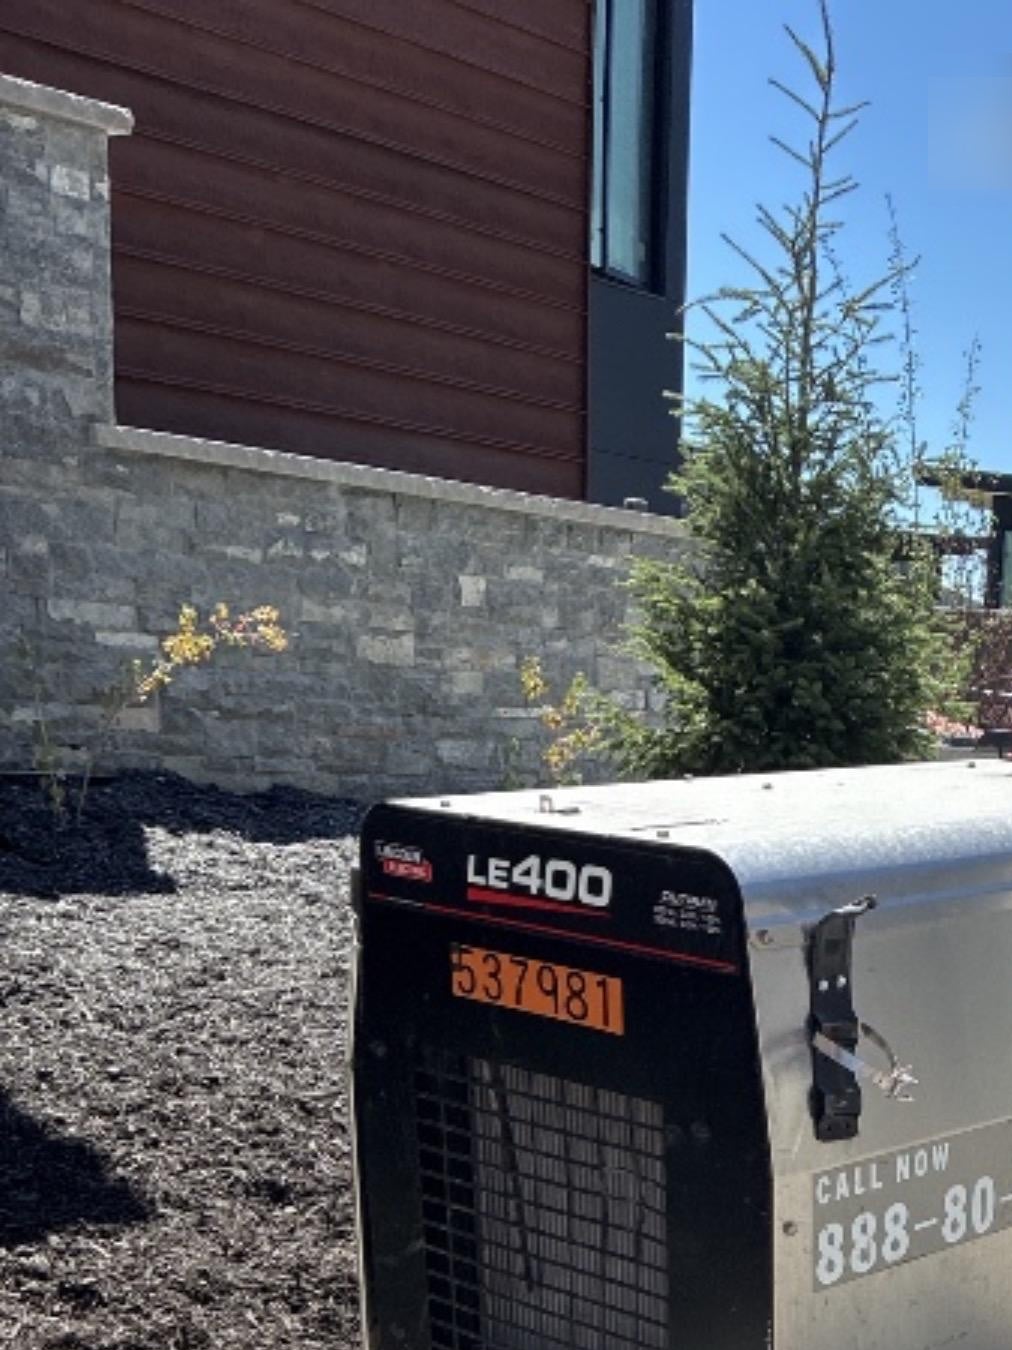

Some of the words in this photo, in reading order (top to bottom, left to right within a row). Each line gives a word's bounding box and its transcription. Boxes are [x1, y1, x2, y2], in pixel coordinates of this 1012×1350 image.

[467, 853, 613, 908] LE400
[457, 950, 612, 1029] 537981
[816, 1163, 884, 1204] CALL
[896, 1142, 951, 1184] NOW
